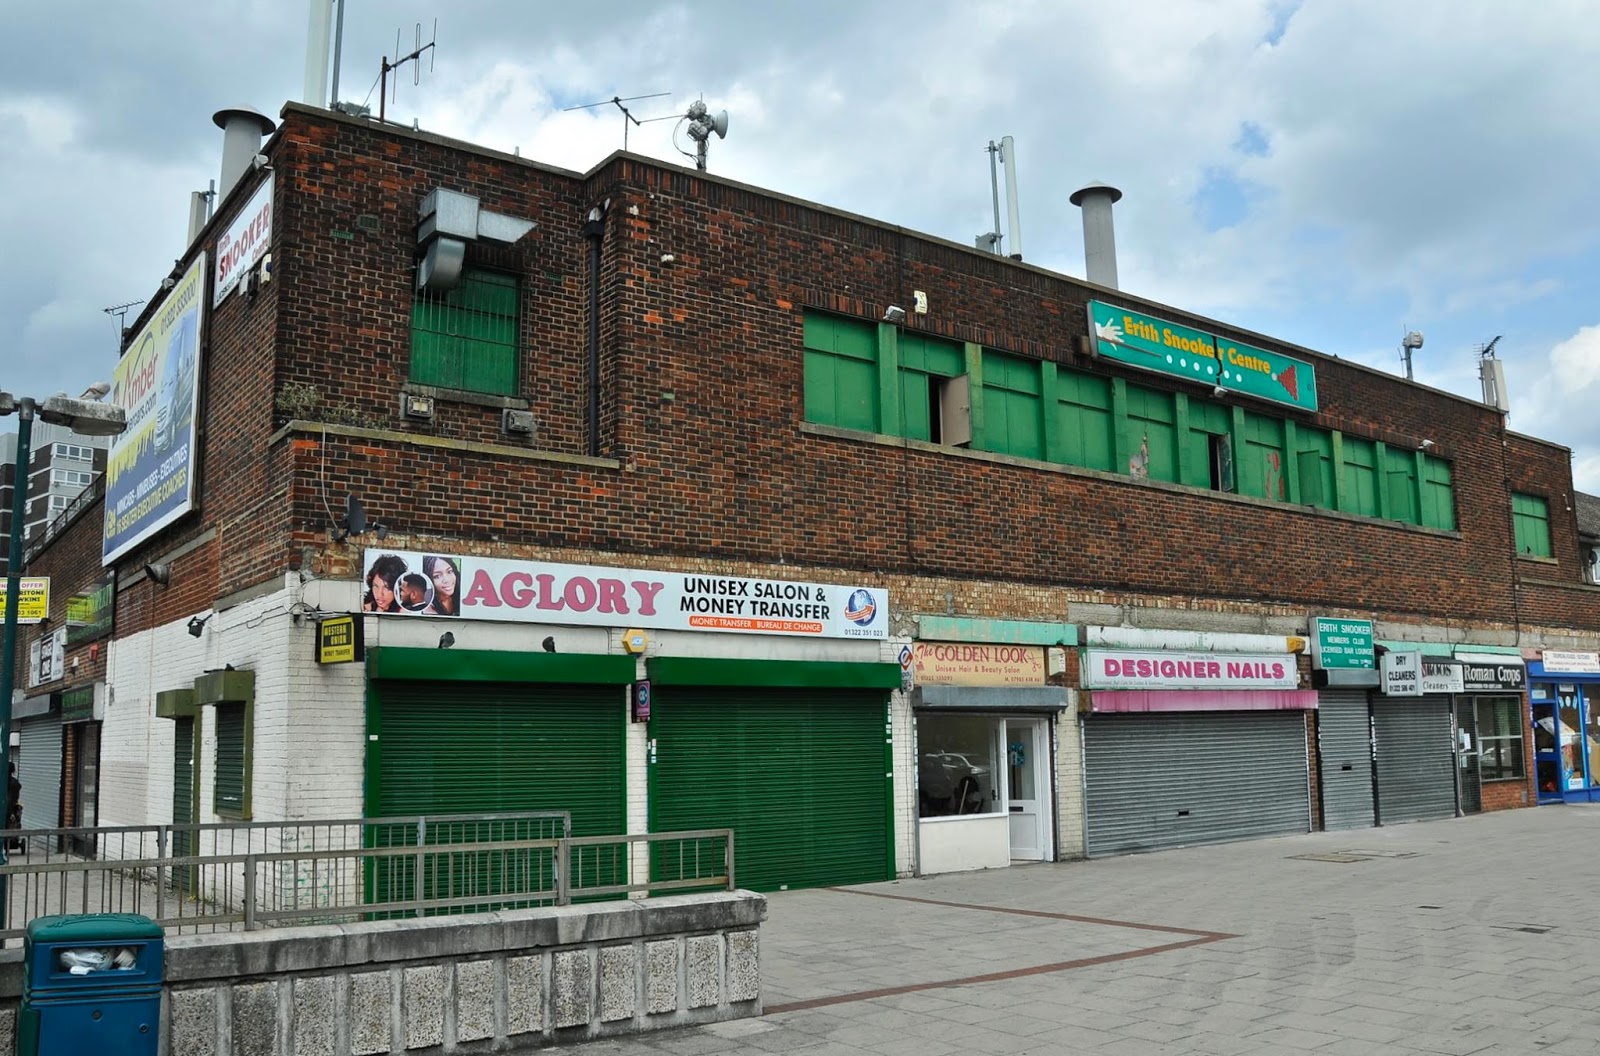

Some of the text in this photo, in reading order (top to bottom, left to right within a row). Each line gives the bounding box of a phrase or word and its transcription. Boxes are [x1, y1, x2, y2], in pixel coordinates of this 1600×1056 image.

[219, 202, 270, 282] SNOOKER
[1123, 316, 1271, 374] Erith Snooker Centre
[122, 353, 159, 410] Amber
[462, 569, 664, 616] AGLORY
[683, 577, 826, 602] UNISEX SALON &
[680, 596, 830, 620] MONEY TRANSFER
[691, 618, 821, 632] MONEY TRANSFER BUREAU DE CHANGE
[1319, 622, 1371, 635] ERITH SNOOKER
[1327, 636, 1349, 645] MEMBERS
[915, 644, 1029, 664] The GOLDEN LOOK
[1395, 655, 1407, 666] DRY
[935, 664, 956, 673] Unisex
[958, 665, 972, 673] Hair
[981, 665, 1001, 675] Beauty
[1004, 666, 1020, 674] Salon
[1104, 659, 1285, 680] DESIGNER NAILS
[1388, 670, 1416, 682] CLEANERS
[1463, 664, 1521, 686] Roman Crops
[1422, 681, 1449, 690] Cleaners
